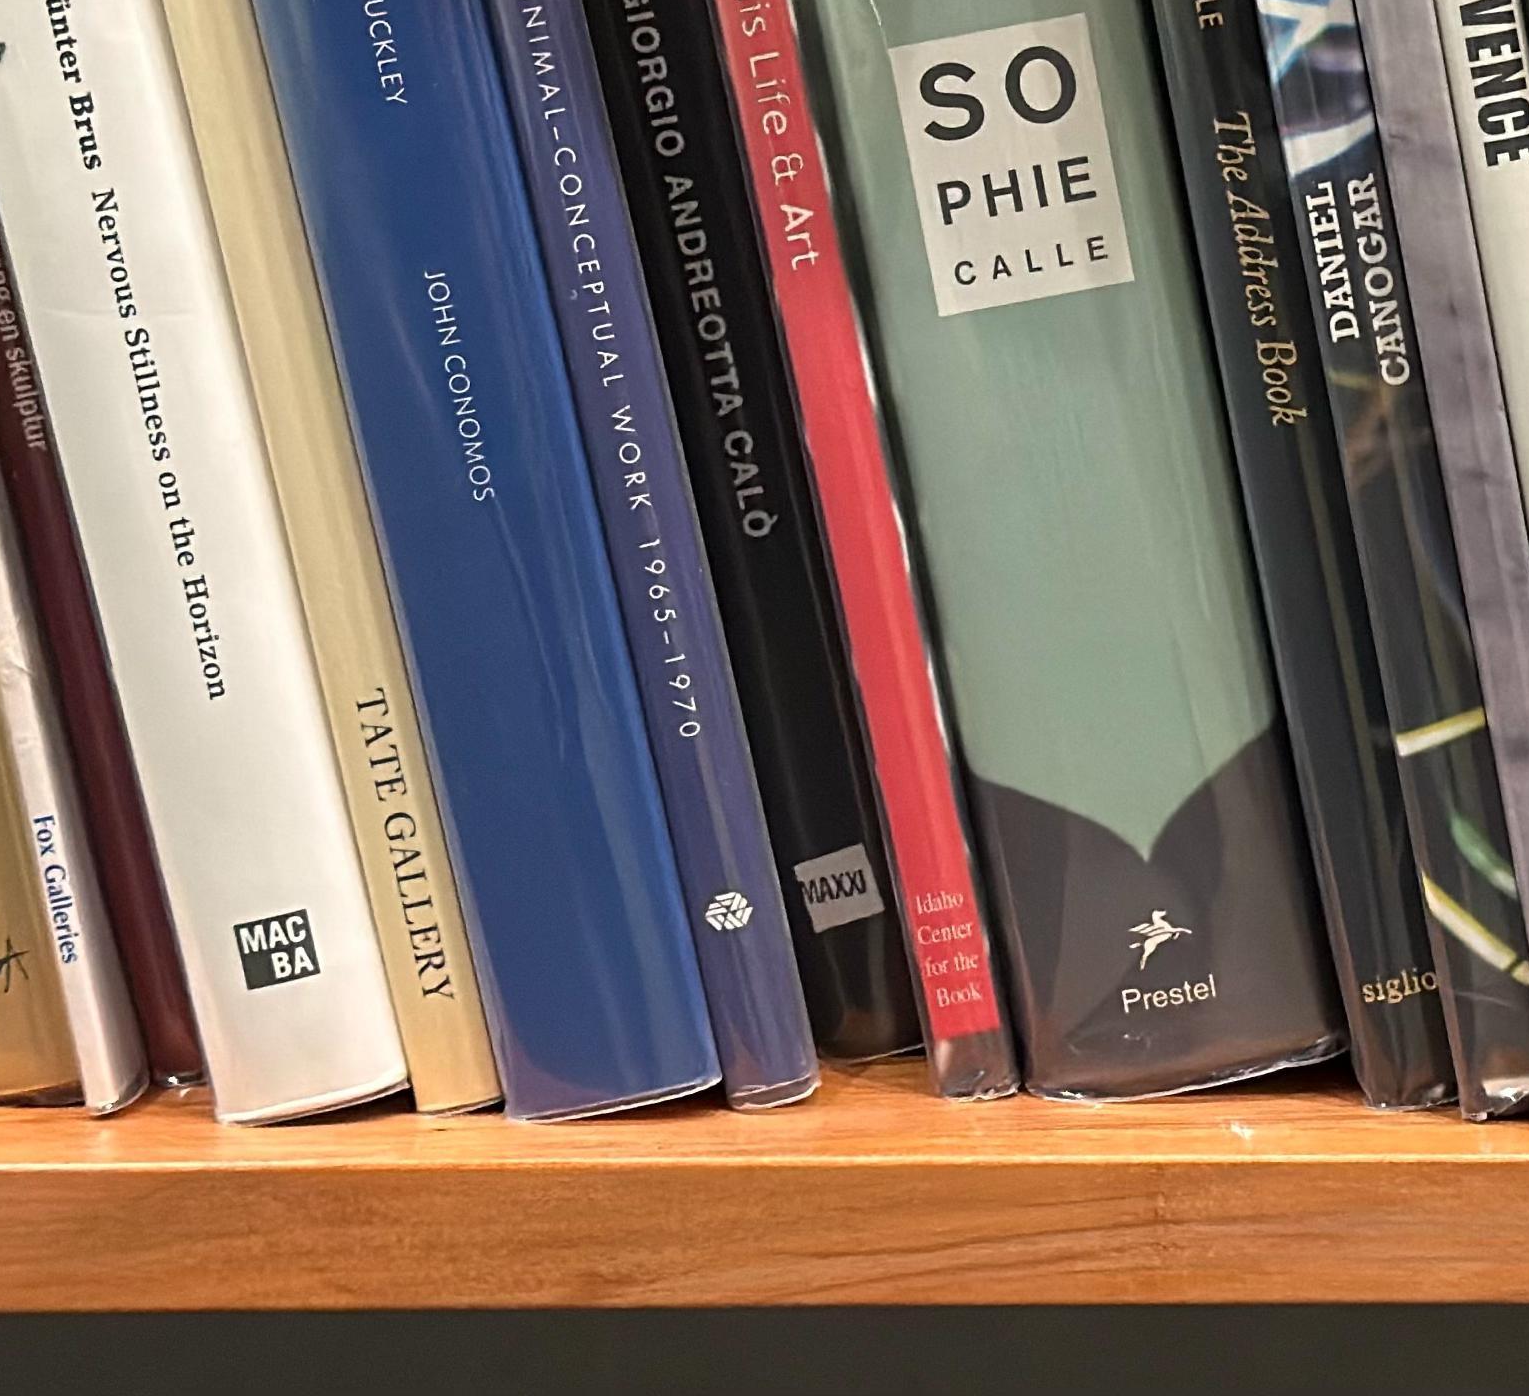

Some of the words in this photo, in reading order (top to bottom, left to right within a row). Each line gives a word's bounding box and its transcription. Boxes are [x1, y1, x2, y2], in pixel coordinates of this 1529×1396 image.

[748, 52, 792, 137] Life
[69, 91, 102, 171] Brus
[1213, 110, 1250, 183] The
[771, 153, 806, 188] &
[936, 155, 1097, 225] PHIE
[92, 187, 137, 319] Nervous
[778, 201, 820, 271] Art
[954, 235, 1109, 286] CALLE
[1226, 180, 1278, 328] Address
[1304, 180, 1360, 342] DANIEL
[1348, 172, 1411, 386] CANOGAR
[424, 269, 460, 346] JOHN
[444, 352, 495, 502] CONOMOS
[664, 171, 742, 419] ANDREOTTA
[724, 430, 779, 540] CALÒ
[1255, 339, 1309, 427] Book
[124, 326, 171, 463] Stillness
[159, 473, 183, 511] on
[170, 516, 195, 568] the
[611, 404, 653, 511] WORK
[638, 538, 702, 739] 1965-1970
[182, 576, 226, 701] Horizon
[32, 814, 58, 858] Fox
[357, 687, 405, 803] TATE
[383, 809, 455, 1003] GALLERY
[43, 862, 79, 965] Galleries
[800, 868, 868, 906] MAXXI
[915, 888, 965, 917] Idaho
[238, 913, 309, 956] MAC
[273, 948, 315, 981] BA
[917, 919, 974, 947] Center
[923, 955, 951, 979] for
[953, 949, 980, 972] the
[935, 980, 983, 1006] Book
[1120, 974, 1218, 1013] Prestel
[1360, 967, 1438, 1004] siglio
